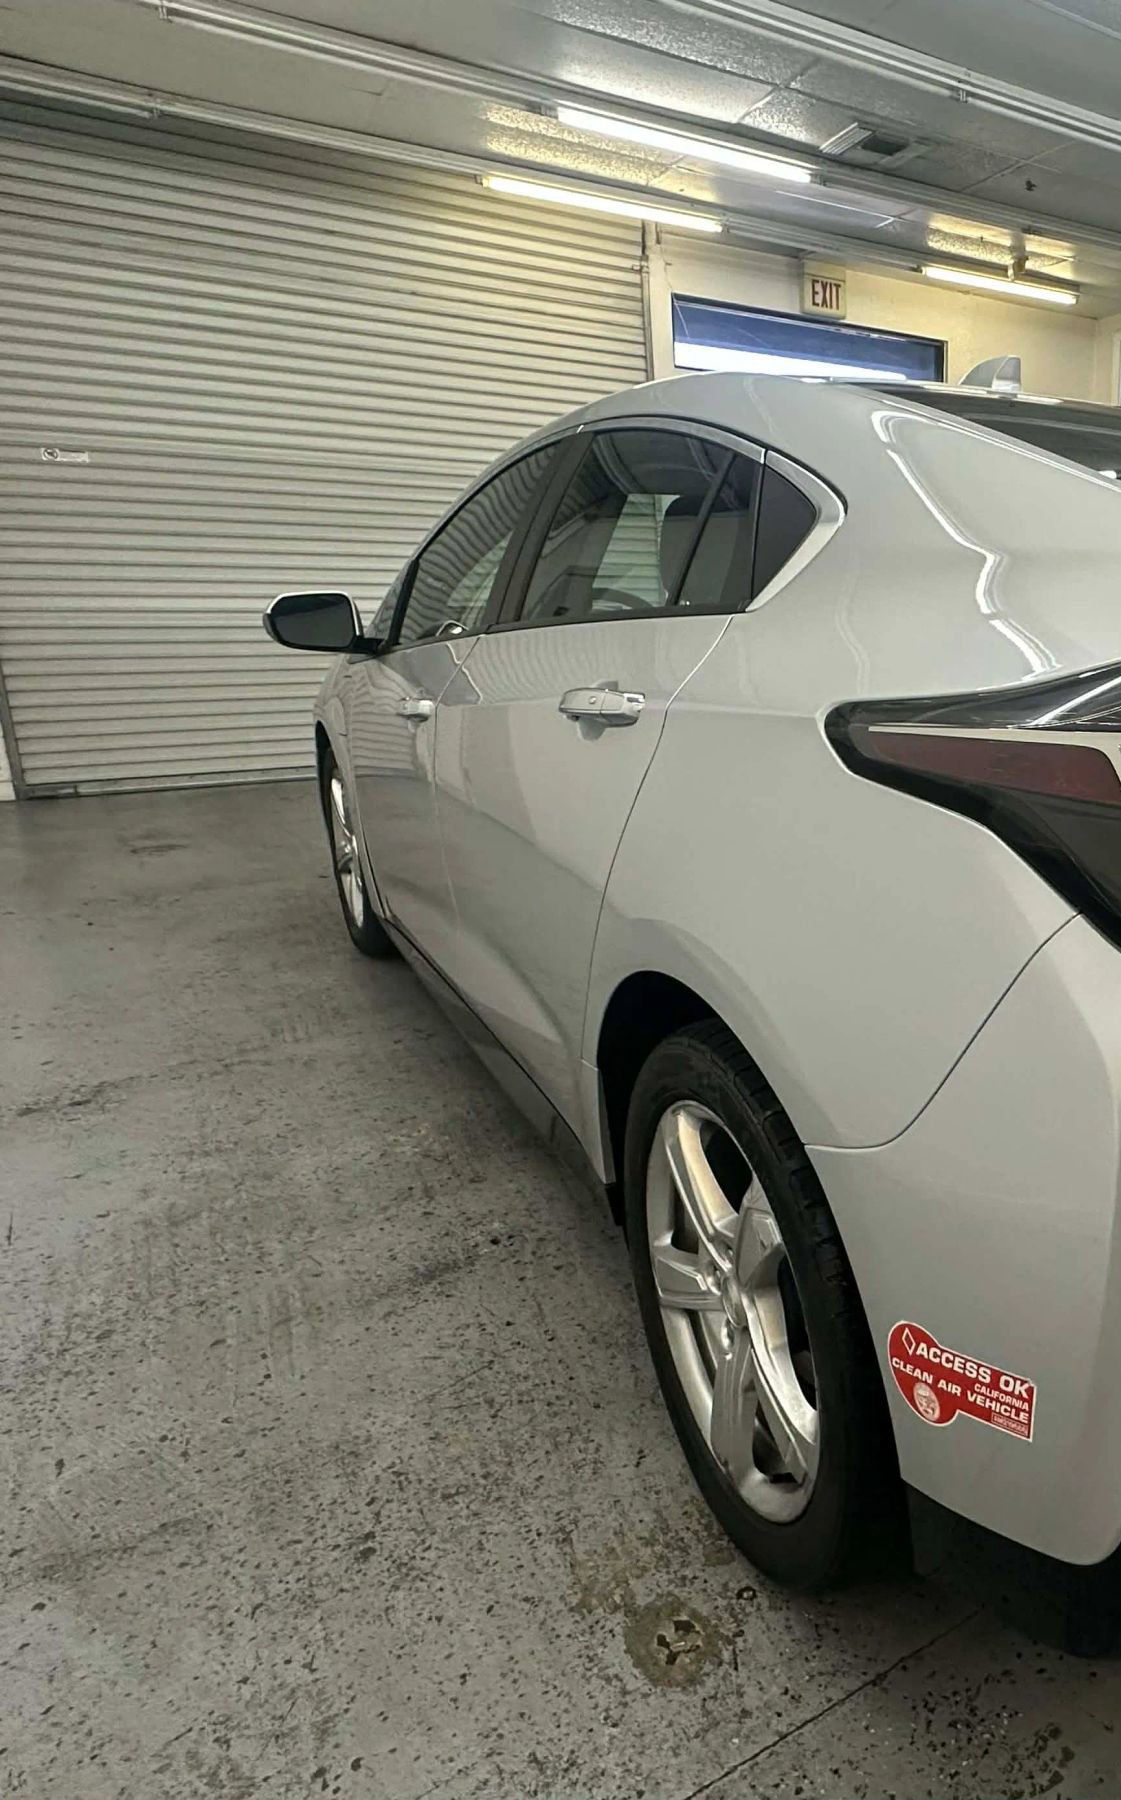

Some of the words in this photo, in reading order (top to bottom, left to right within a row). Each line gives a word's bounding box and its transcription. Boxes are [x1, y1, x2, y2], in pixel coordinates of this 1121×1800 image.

[811, 279, 842, 311] EXIT
[892, 1357, 934, 1384] CLEAN
[937, 1379, 962, 1396] AIR
[967, 1390, 1030, 1424] VEHICLE
[915, 1343, 991, 1384] ACCESS
[999, 1375, 1030, 1399] OK
[974, 1383, 1030, 1411] CALIFORNIA
